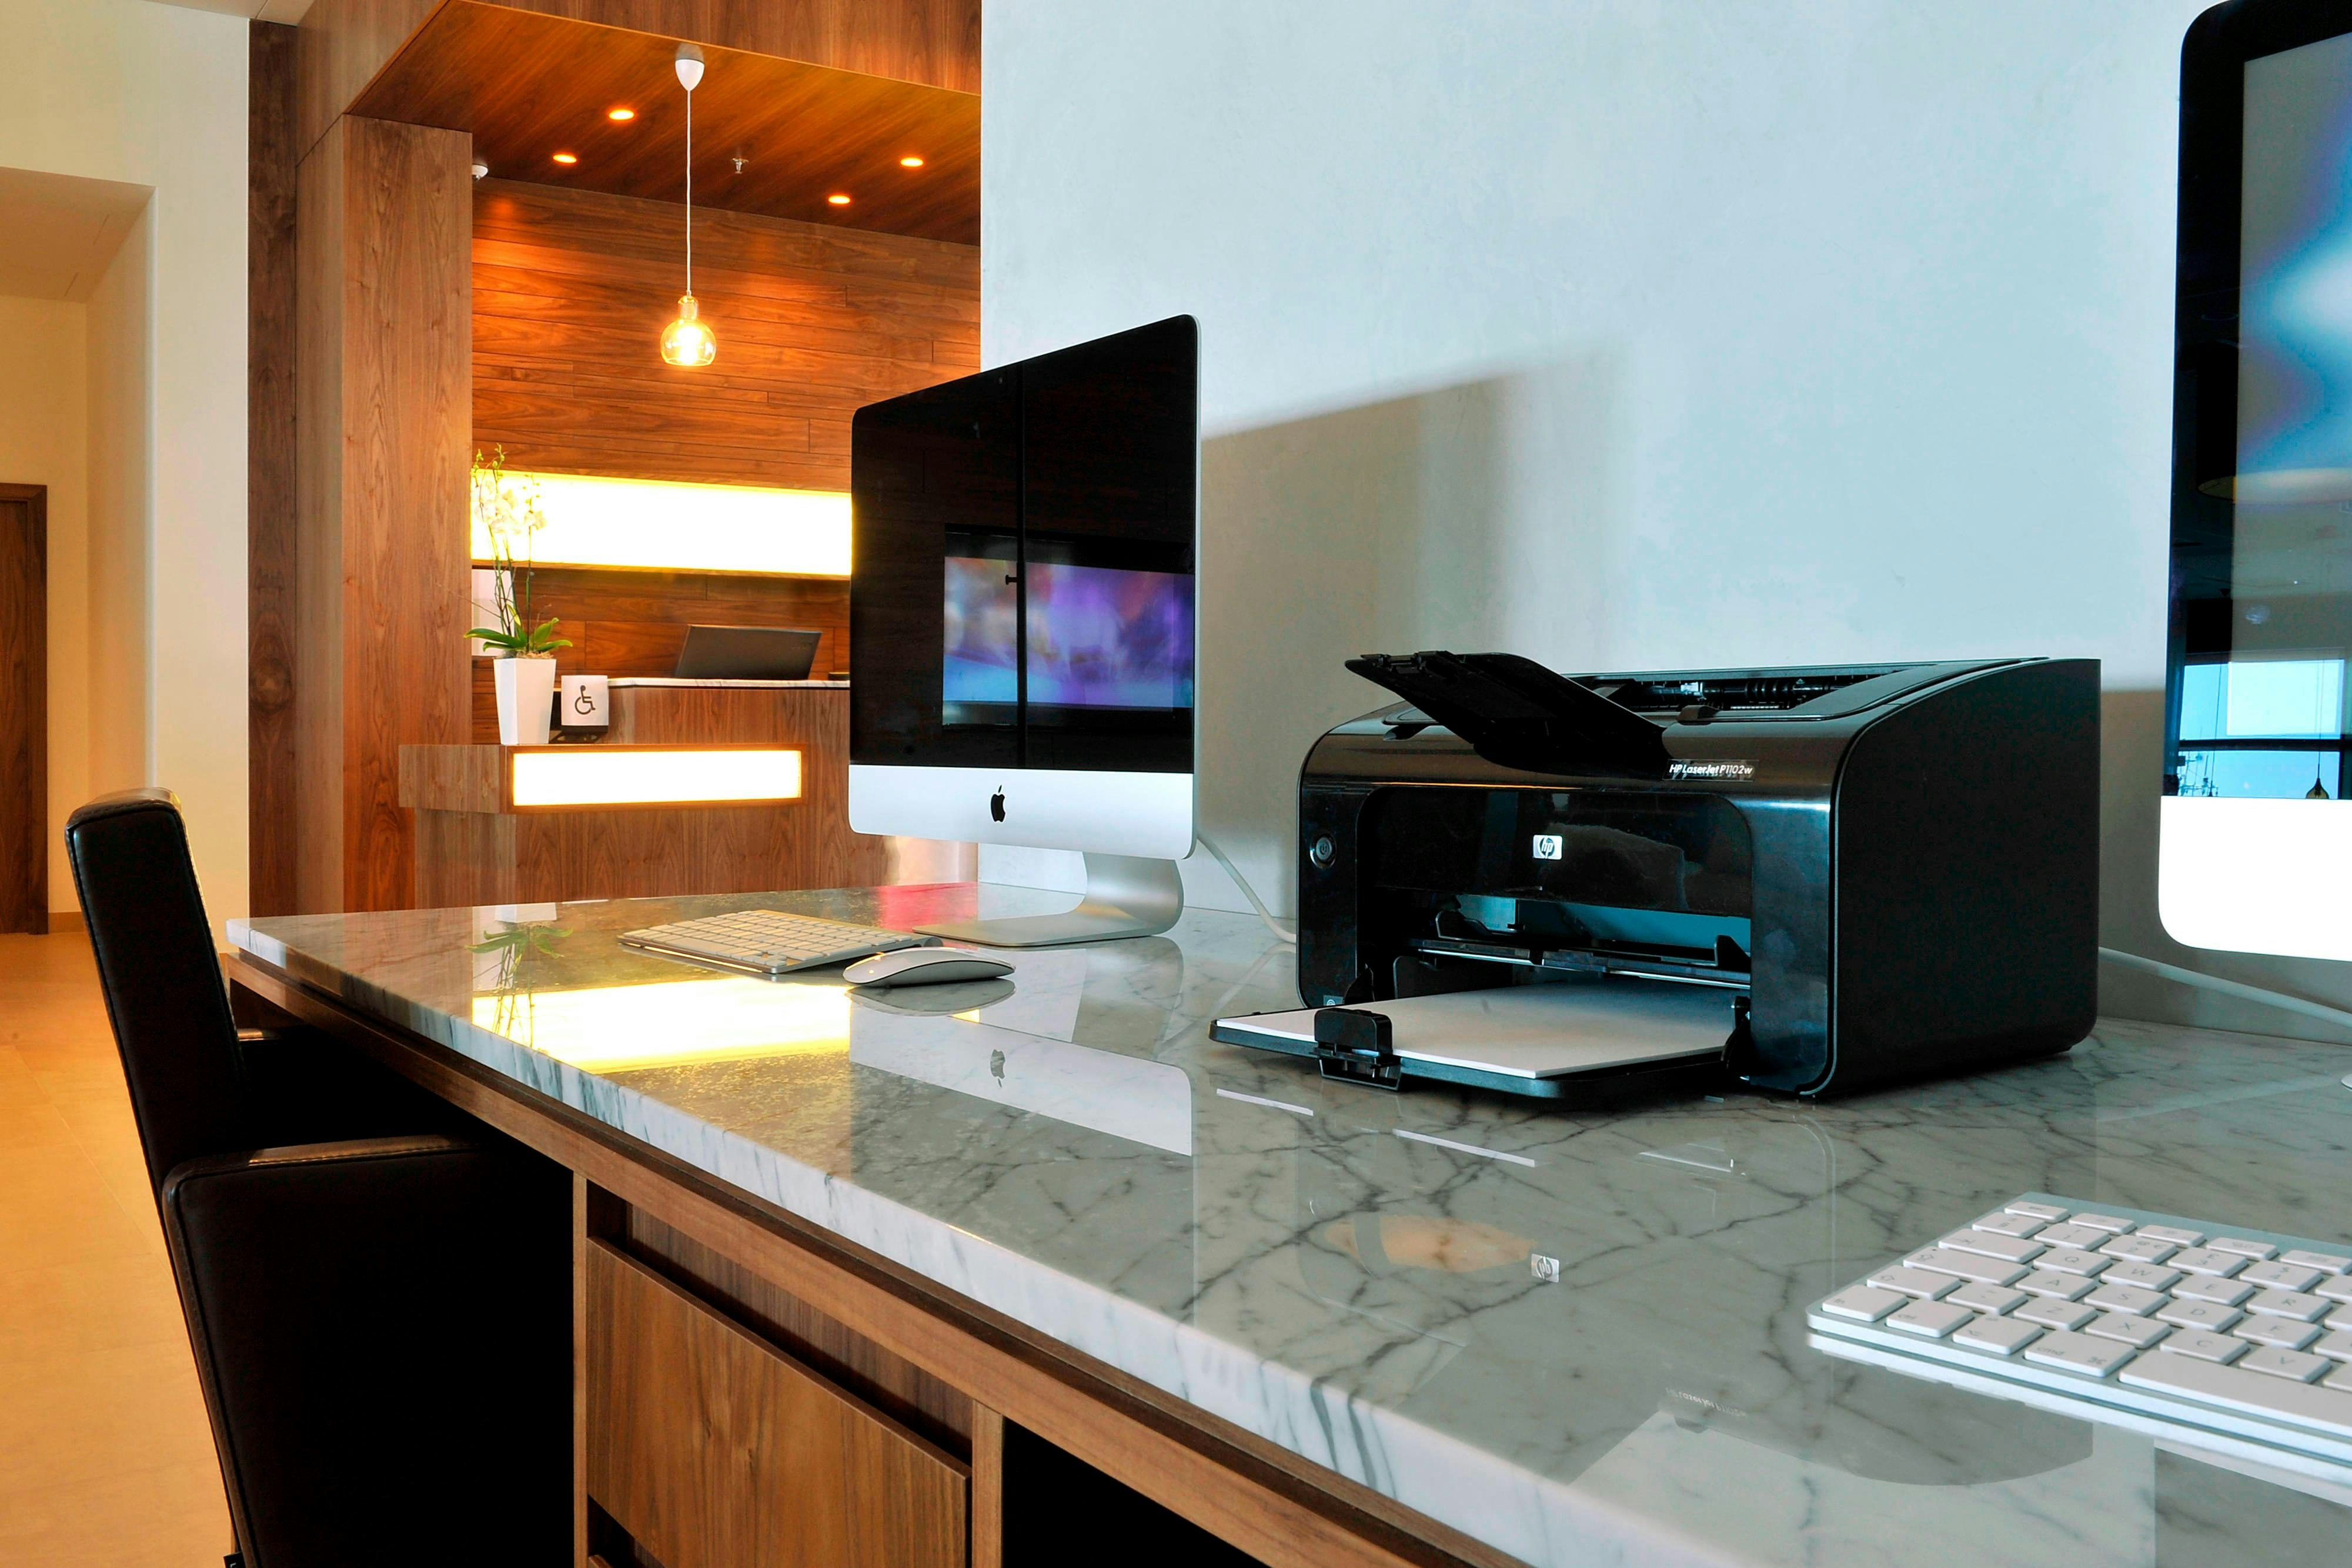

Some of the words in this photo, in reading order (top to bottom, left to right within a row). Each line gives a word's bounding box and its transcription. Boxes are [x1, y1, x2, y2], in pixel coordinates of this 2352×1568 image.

[1669, 764, 1682, 773] HP
[1682, 764, 1719, 775] LaserJet
[1719, 765, 1753, 774] P1102w
[1539, 835, 1555, 859] hp
[2064, 1255, 2080, 1263] Q
[2130, 1268, 2151, 1276] W
[2118, 1322, 2137, 1331] X
